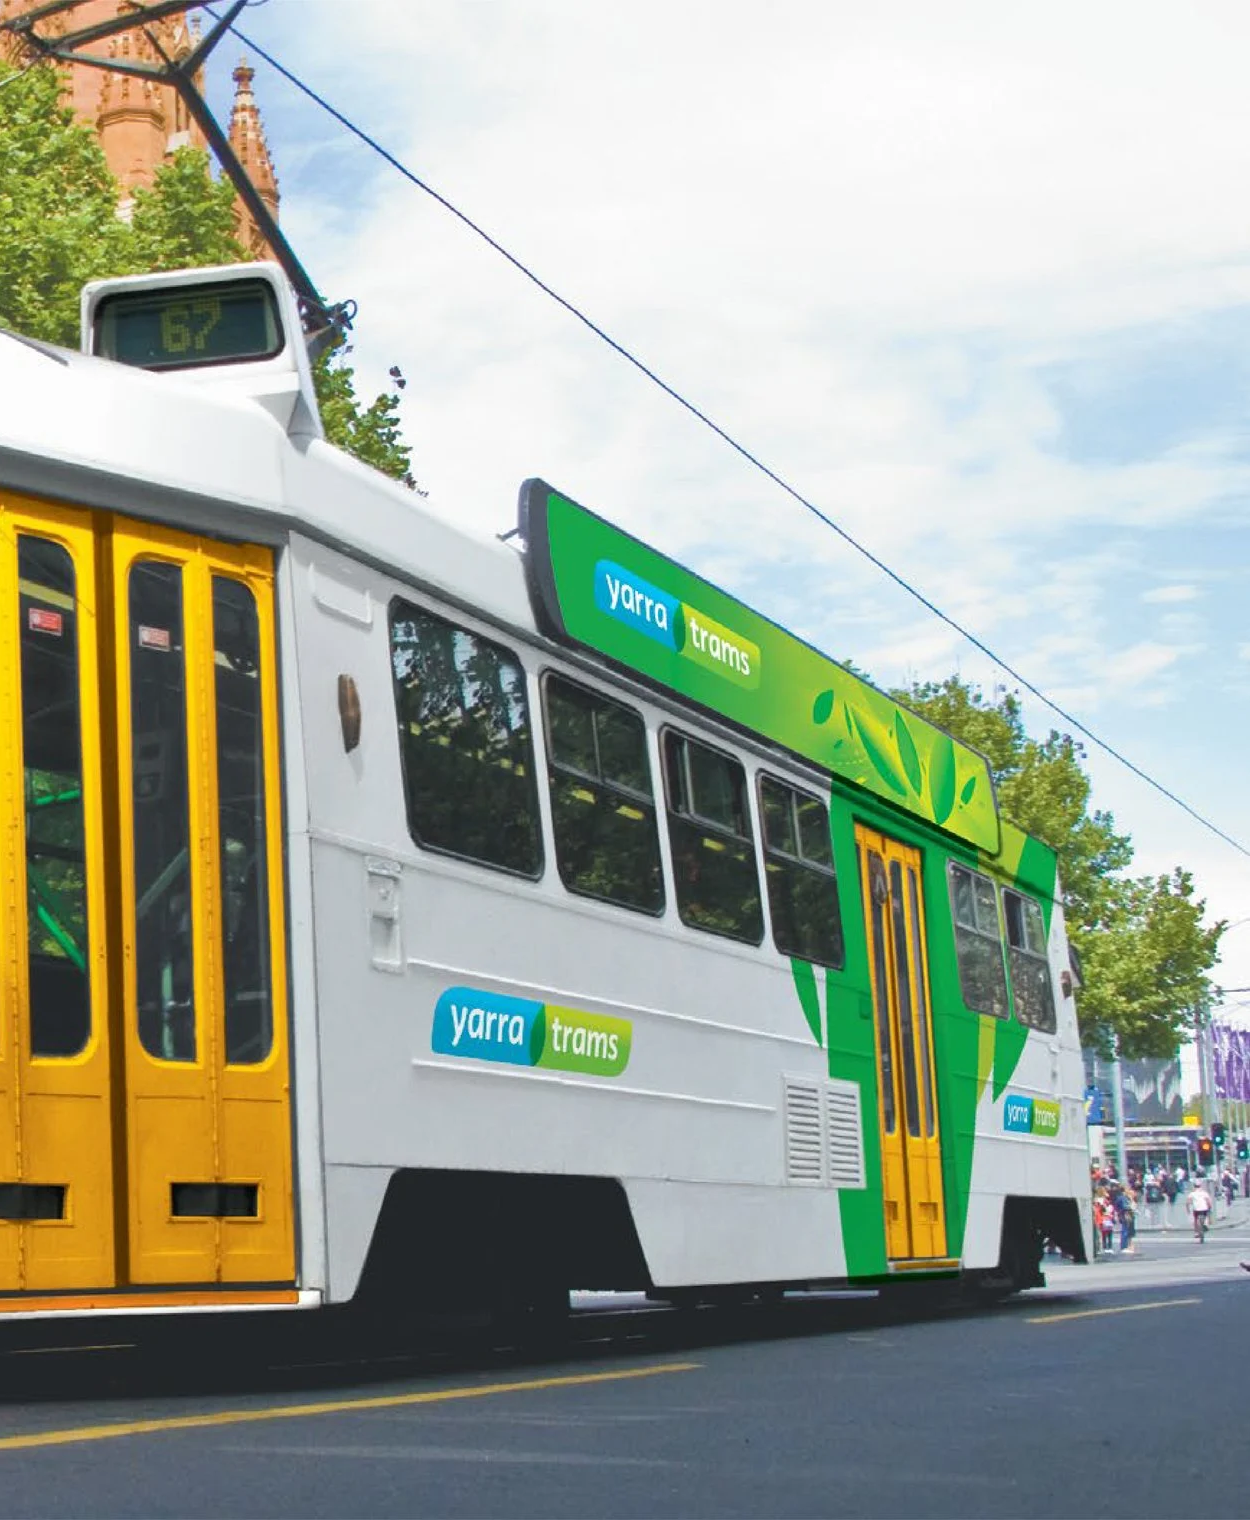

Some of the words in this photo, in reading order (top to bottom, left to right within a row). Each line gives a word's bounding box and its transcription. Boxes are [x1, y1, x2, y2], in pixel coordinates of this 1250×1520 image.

[161, 297, 221, 353] 67
[605, 573, 668, 631] yarra
[689, 617, 751, 676] trams
[451, 1004, 524, 1047] yarra
[552, 1016, 618, 1061] trams
[1007, 1103, 1028, 1126] yarra
